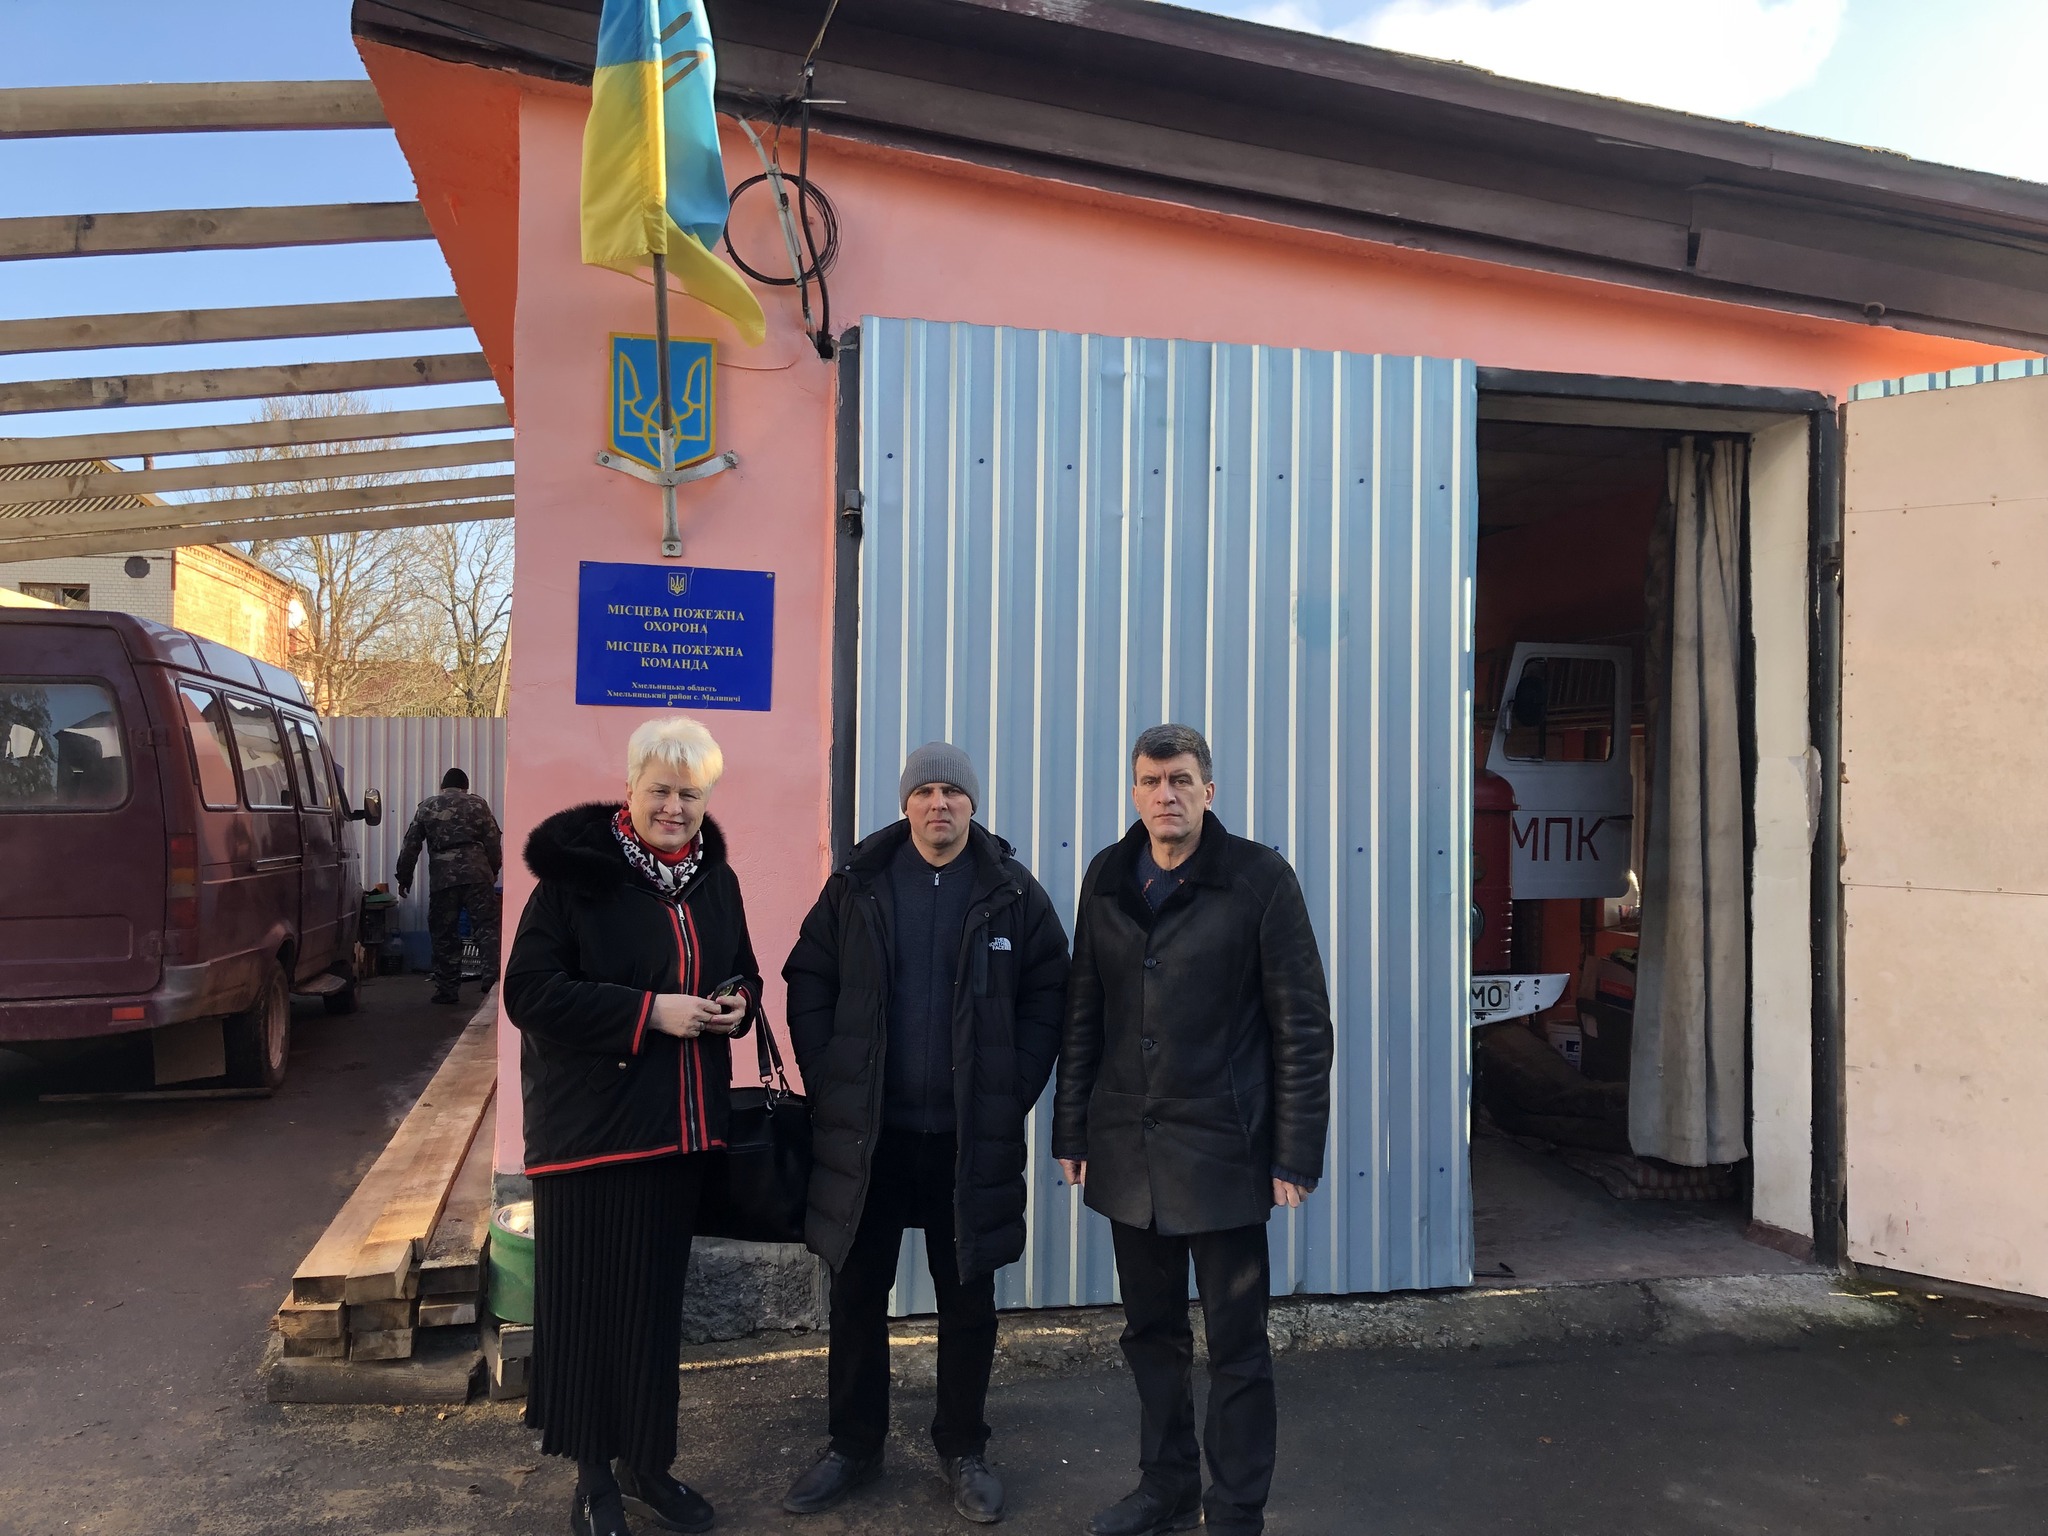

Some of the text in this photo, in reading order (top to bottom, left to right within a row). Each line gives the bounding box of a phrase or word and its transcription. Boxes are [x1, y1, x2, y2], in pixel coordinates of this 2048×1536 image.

[607, 604, 745, 621] МІСЦЕВА ПОЖЕЖНА
[644, 621, 708, 634] ОХОРОНА
[606, 640, 744, 657] МІСЦЕВА ПОЖЕЖНА
[641, 657, 709, 671] КОМАНДА
[632, 681, 717, 692] Хмельницька область
[607, 689, 666, 699] Хмельницький
[669, 693, 692, 701] район
[1512, 817, 1605, 861] МПК
